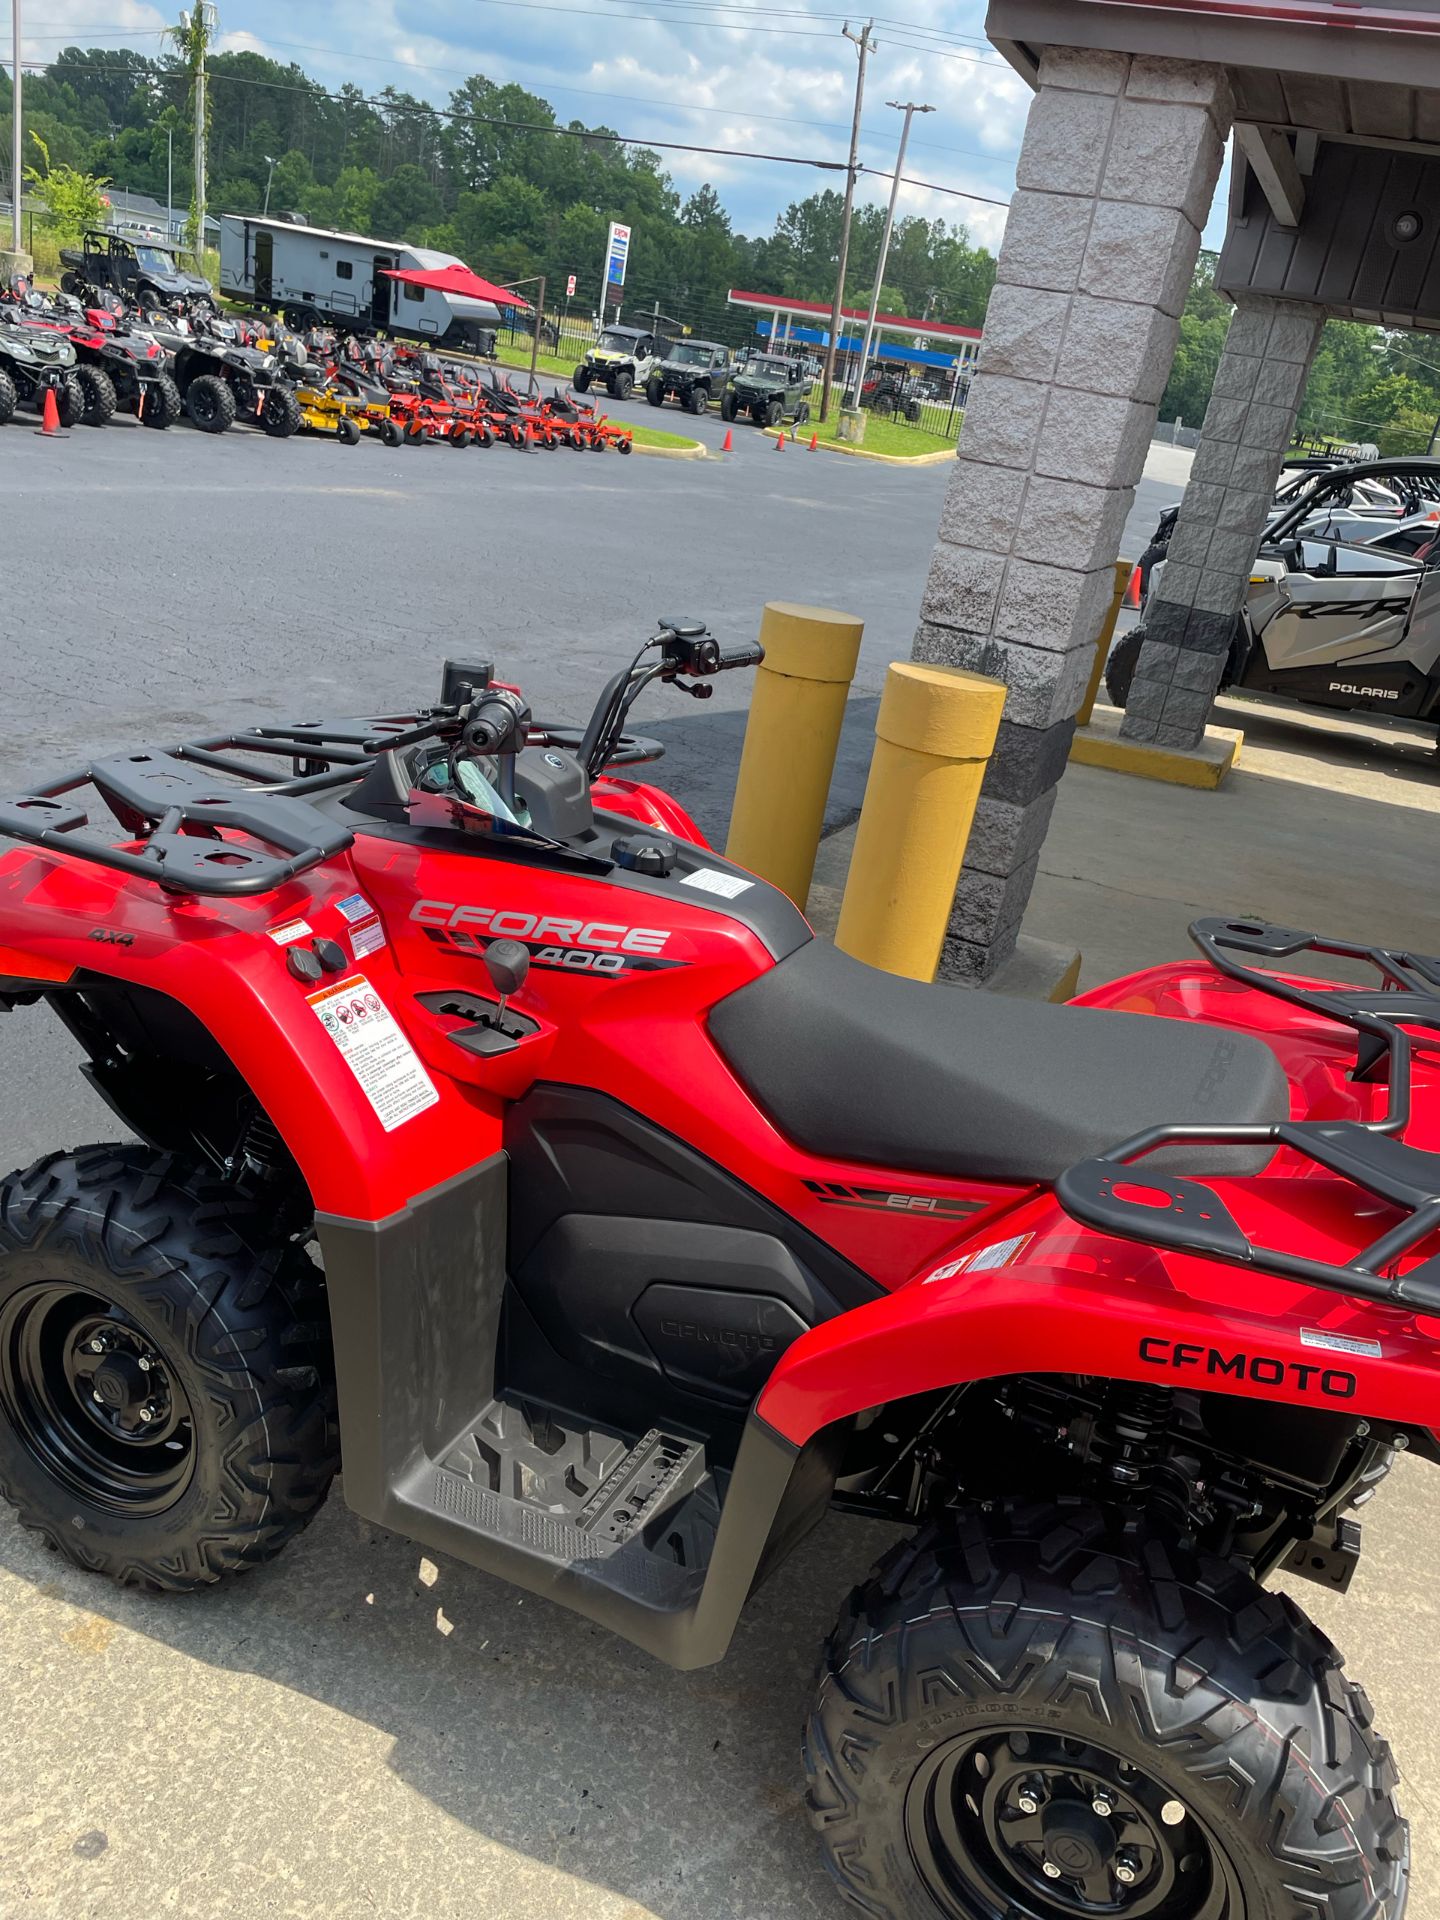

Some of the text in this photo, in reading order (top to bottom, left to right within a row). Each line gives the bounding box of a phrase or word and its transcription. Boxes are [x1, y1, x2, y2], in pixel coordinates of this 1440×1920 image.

[1277, 597, 1413, 620] RZR
[1329, 682, 1399, 700] POLARIS
[409, 899, 671, 954] CFORCE
[534, 947, 626, 972] 400
[886, 1193, 937, 1212] EFI
[660, 1320, 777, 1352] CFMOTO
[1138, 1336, 1357, 1399] CFMOTO
